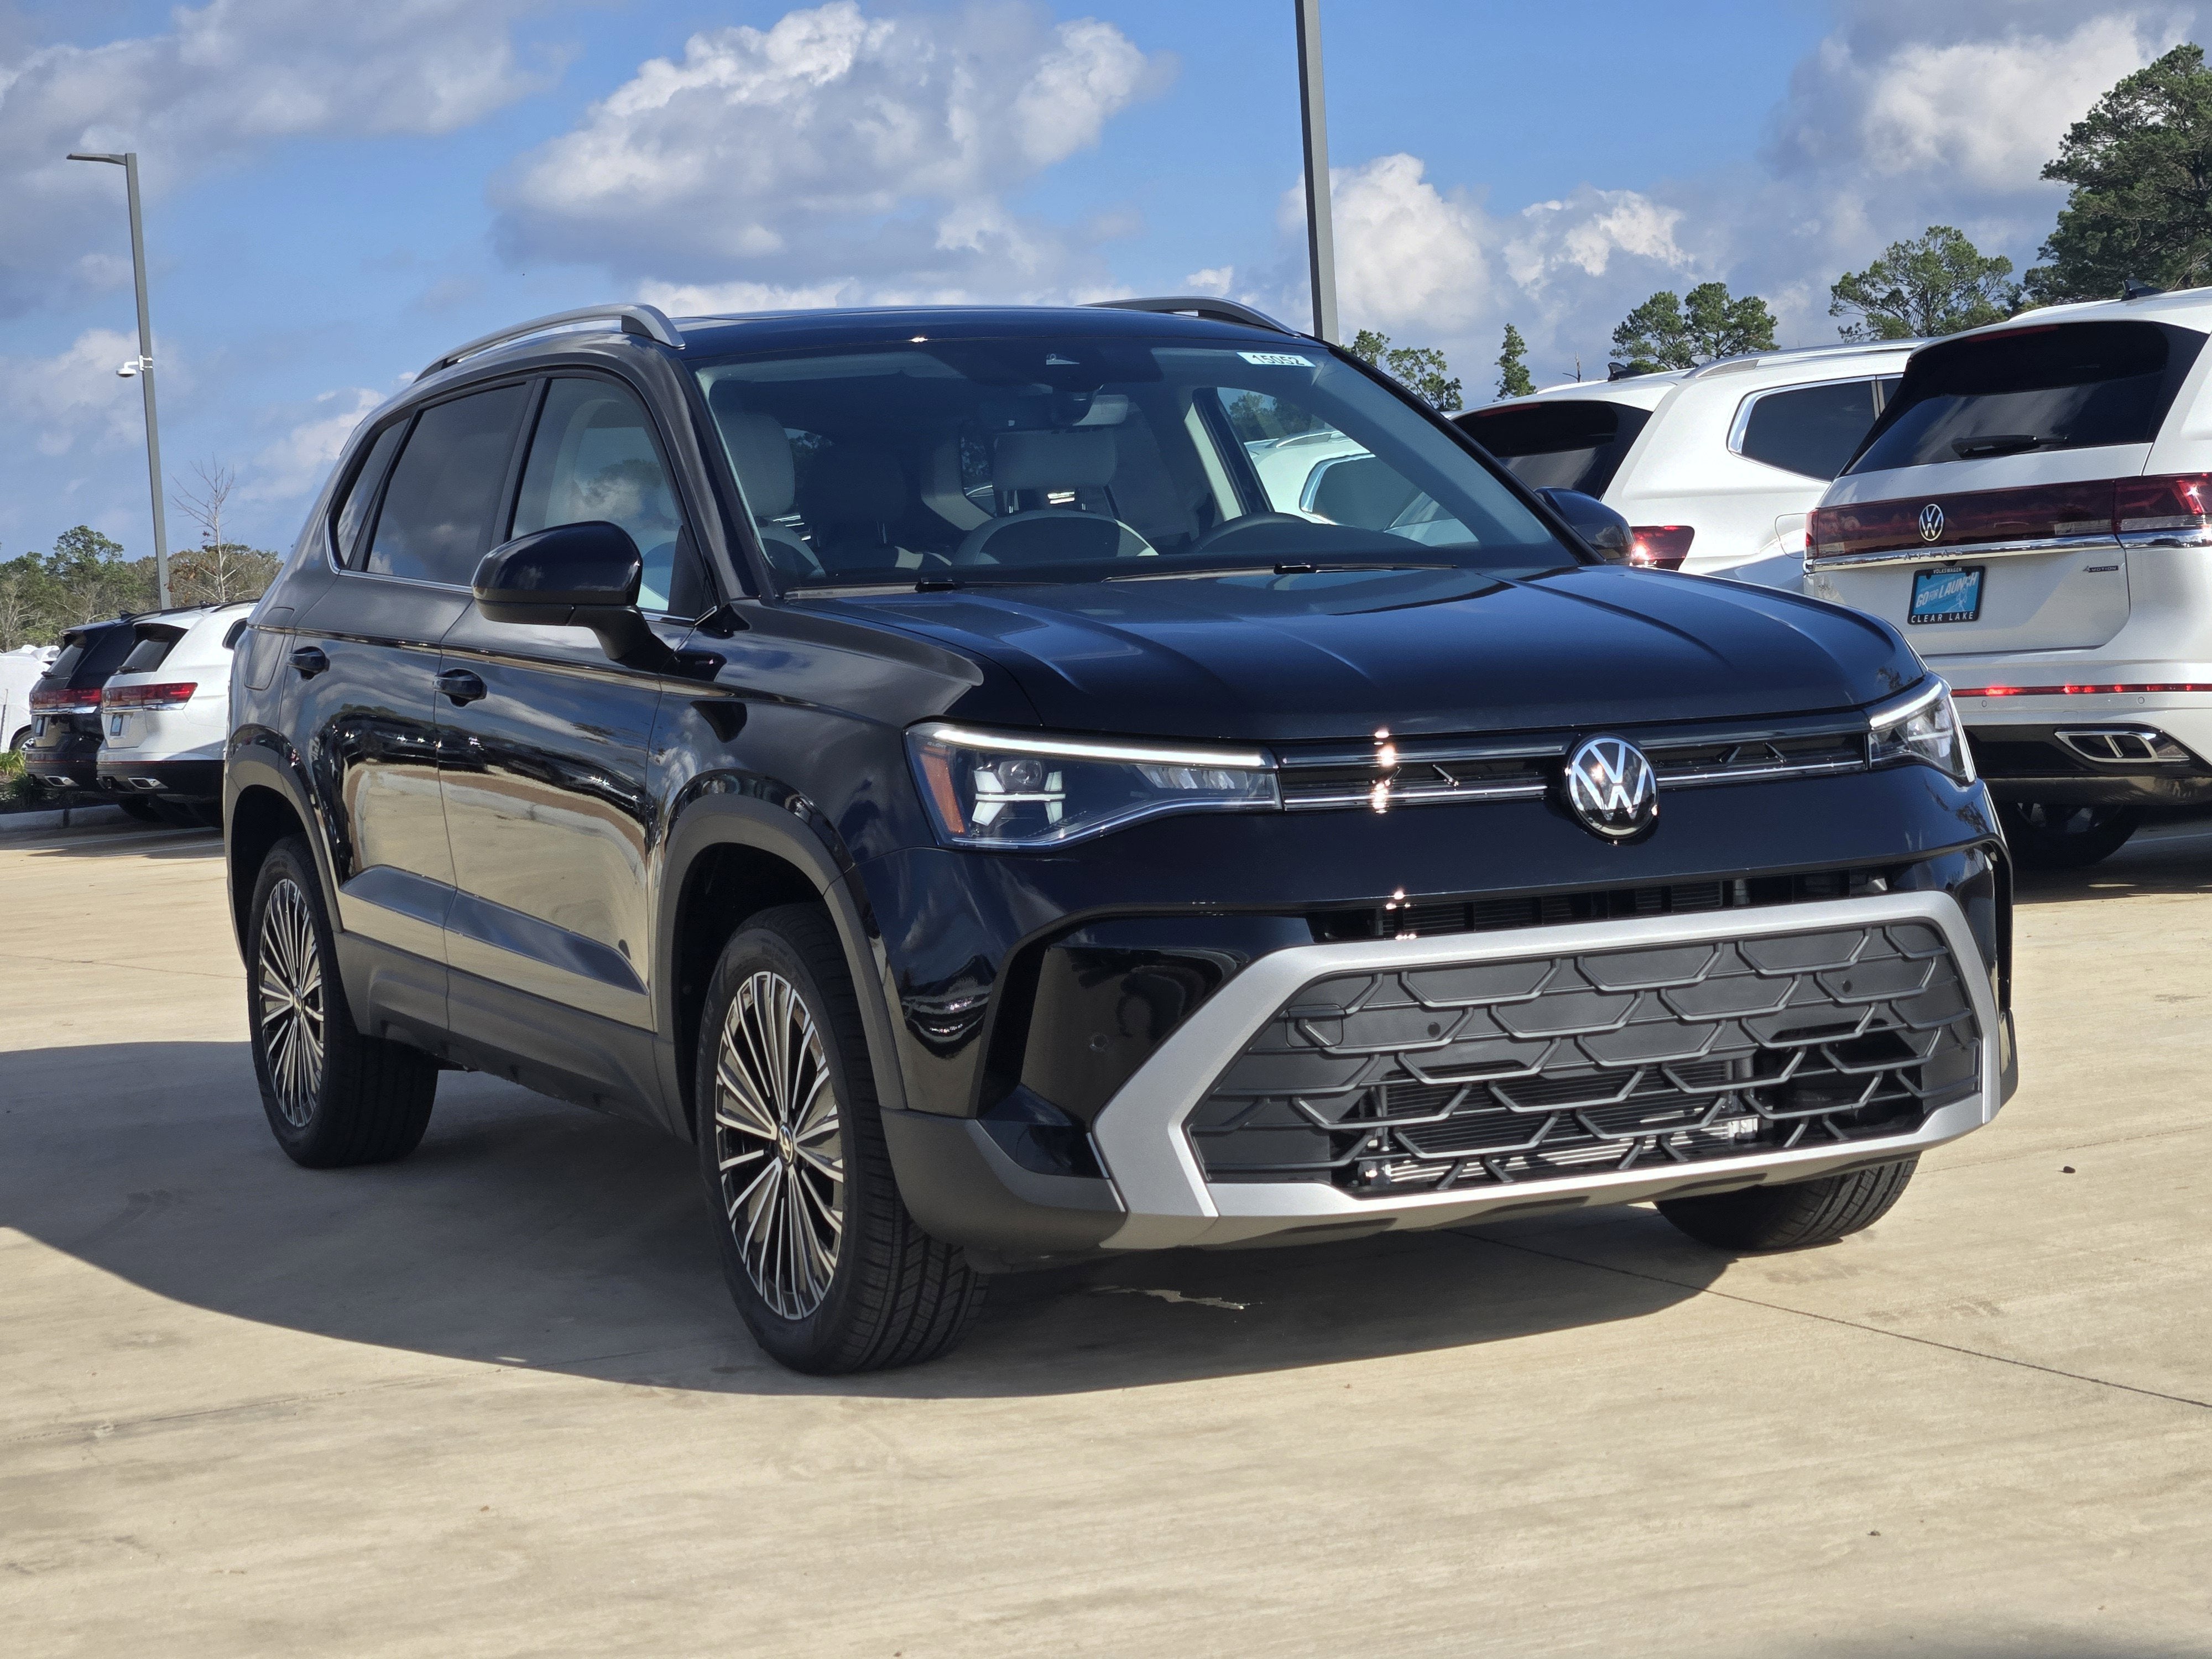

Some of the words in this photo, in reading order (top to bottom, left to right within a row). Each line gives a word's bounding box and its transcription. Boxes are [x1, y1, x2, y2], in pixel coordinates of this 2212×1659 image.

[1252, 354, 1305, 366] 15052
[1919, 504, 1943, 540] VW
[1903, 548, 1963, 560] ATLAS
[1916, 591, 1929, 608] GO
[1911, 614, 1943, 623] CLEAR
[1949, 612, 1974, 620] LAKE
[1572, 739, 1656, 832] VW
